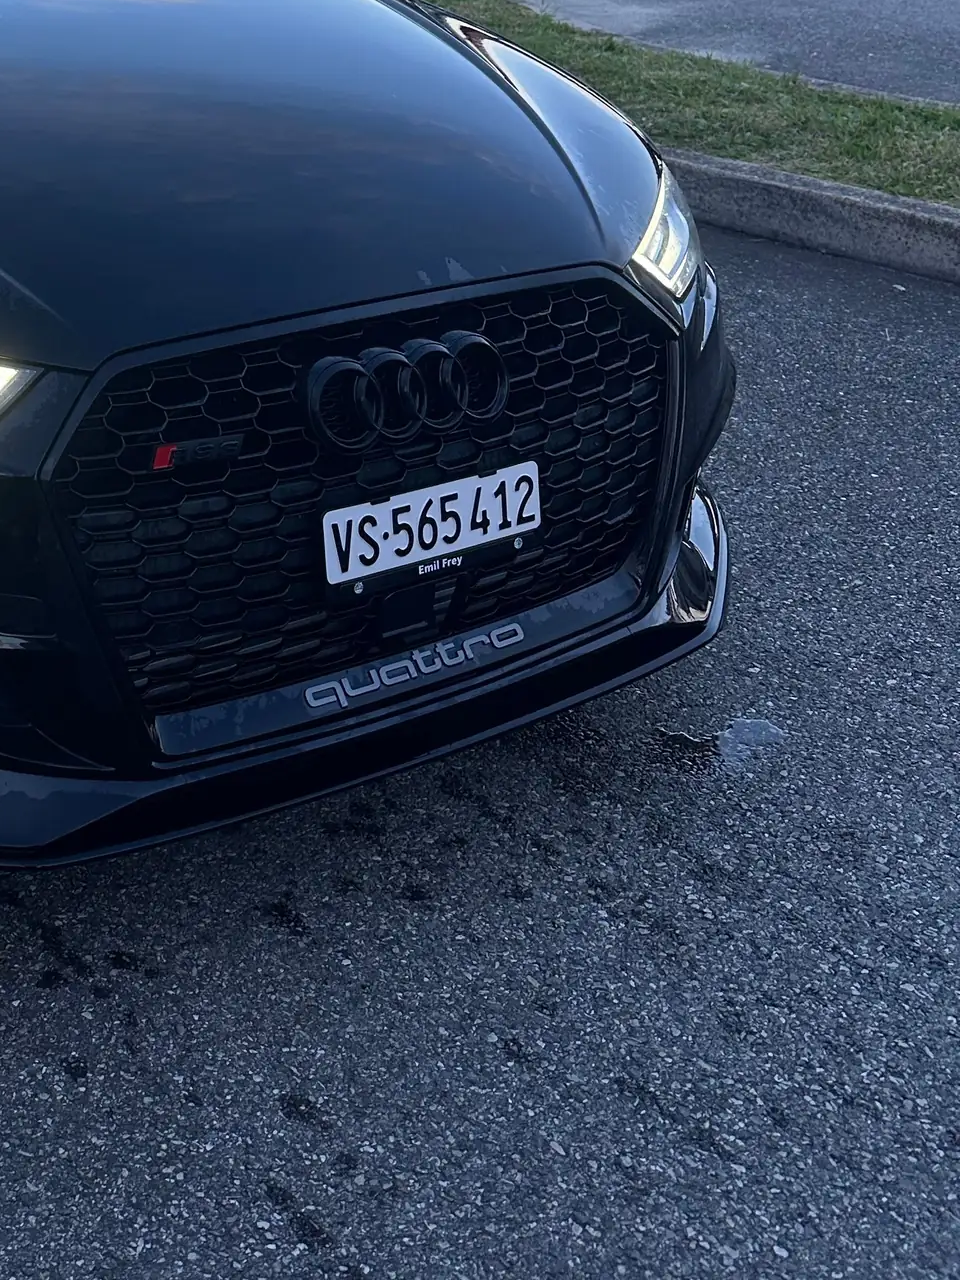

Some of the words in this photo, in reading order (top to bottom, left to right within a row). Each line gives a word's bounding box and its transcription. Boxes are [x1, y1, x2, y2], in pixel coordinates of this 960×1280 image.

[418, 559, 440, 575] Emil
[442, 555, 463, 568] Frey
[304, 622, 525, 708] quattro
